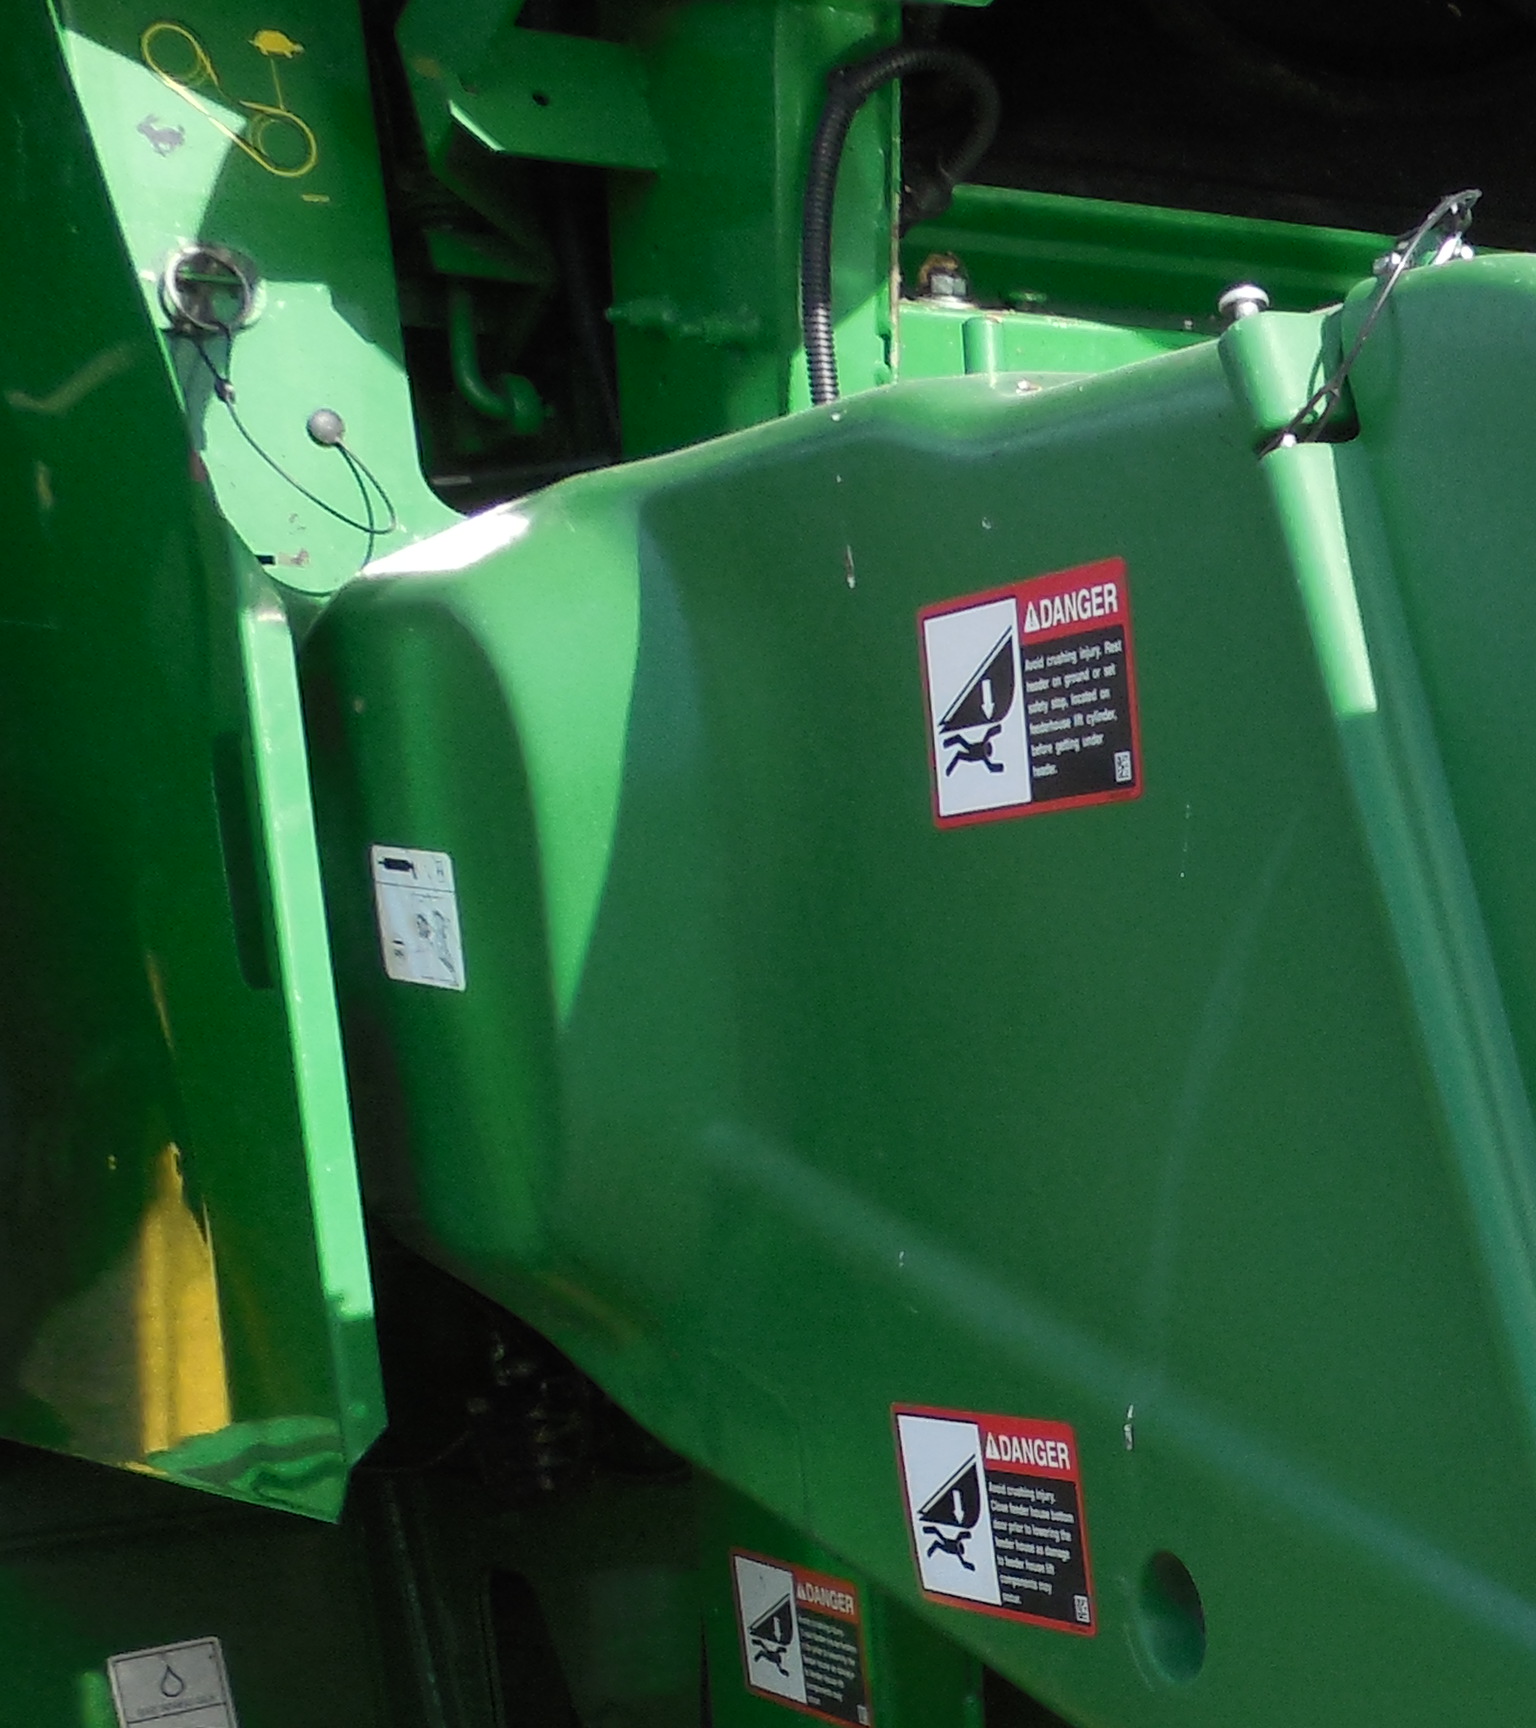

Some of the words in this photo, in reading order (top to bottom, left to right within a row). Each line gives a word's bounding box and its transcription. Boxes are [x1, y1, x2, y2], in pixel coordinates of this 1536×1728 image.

[1040, 583, 1119, 629] DANGER
[999, 1435, 1071, 1470] DANGER
[806, 1582, 855, 1615] DANGER
